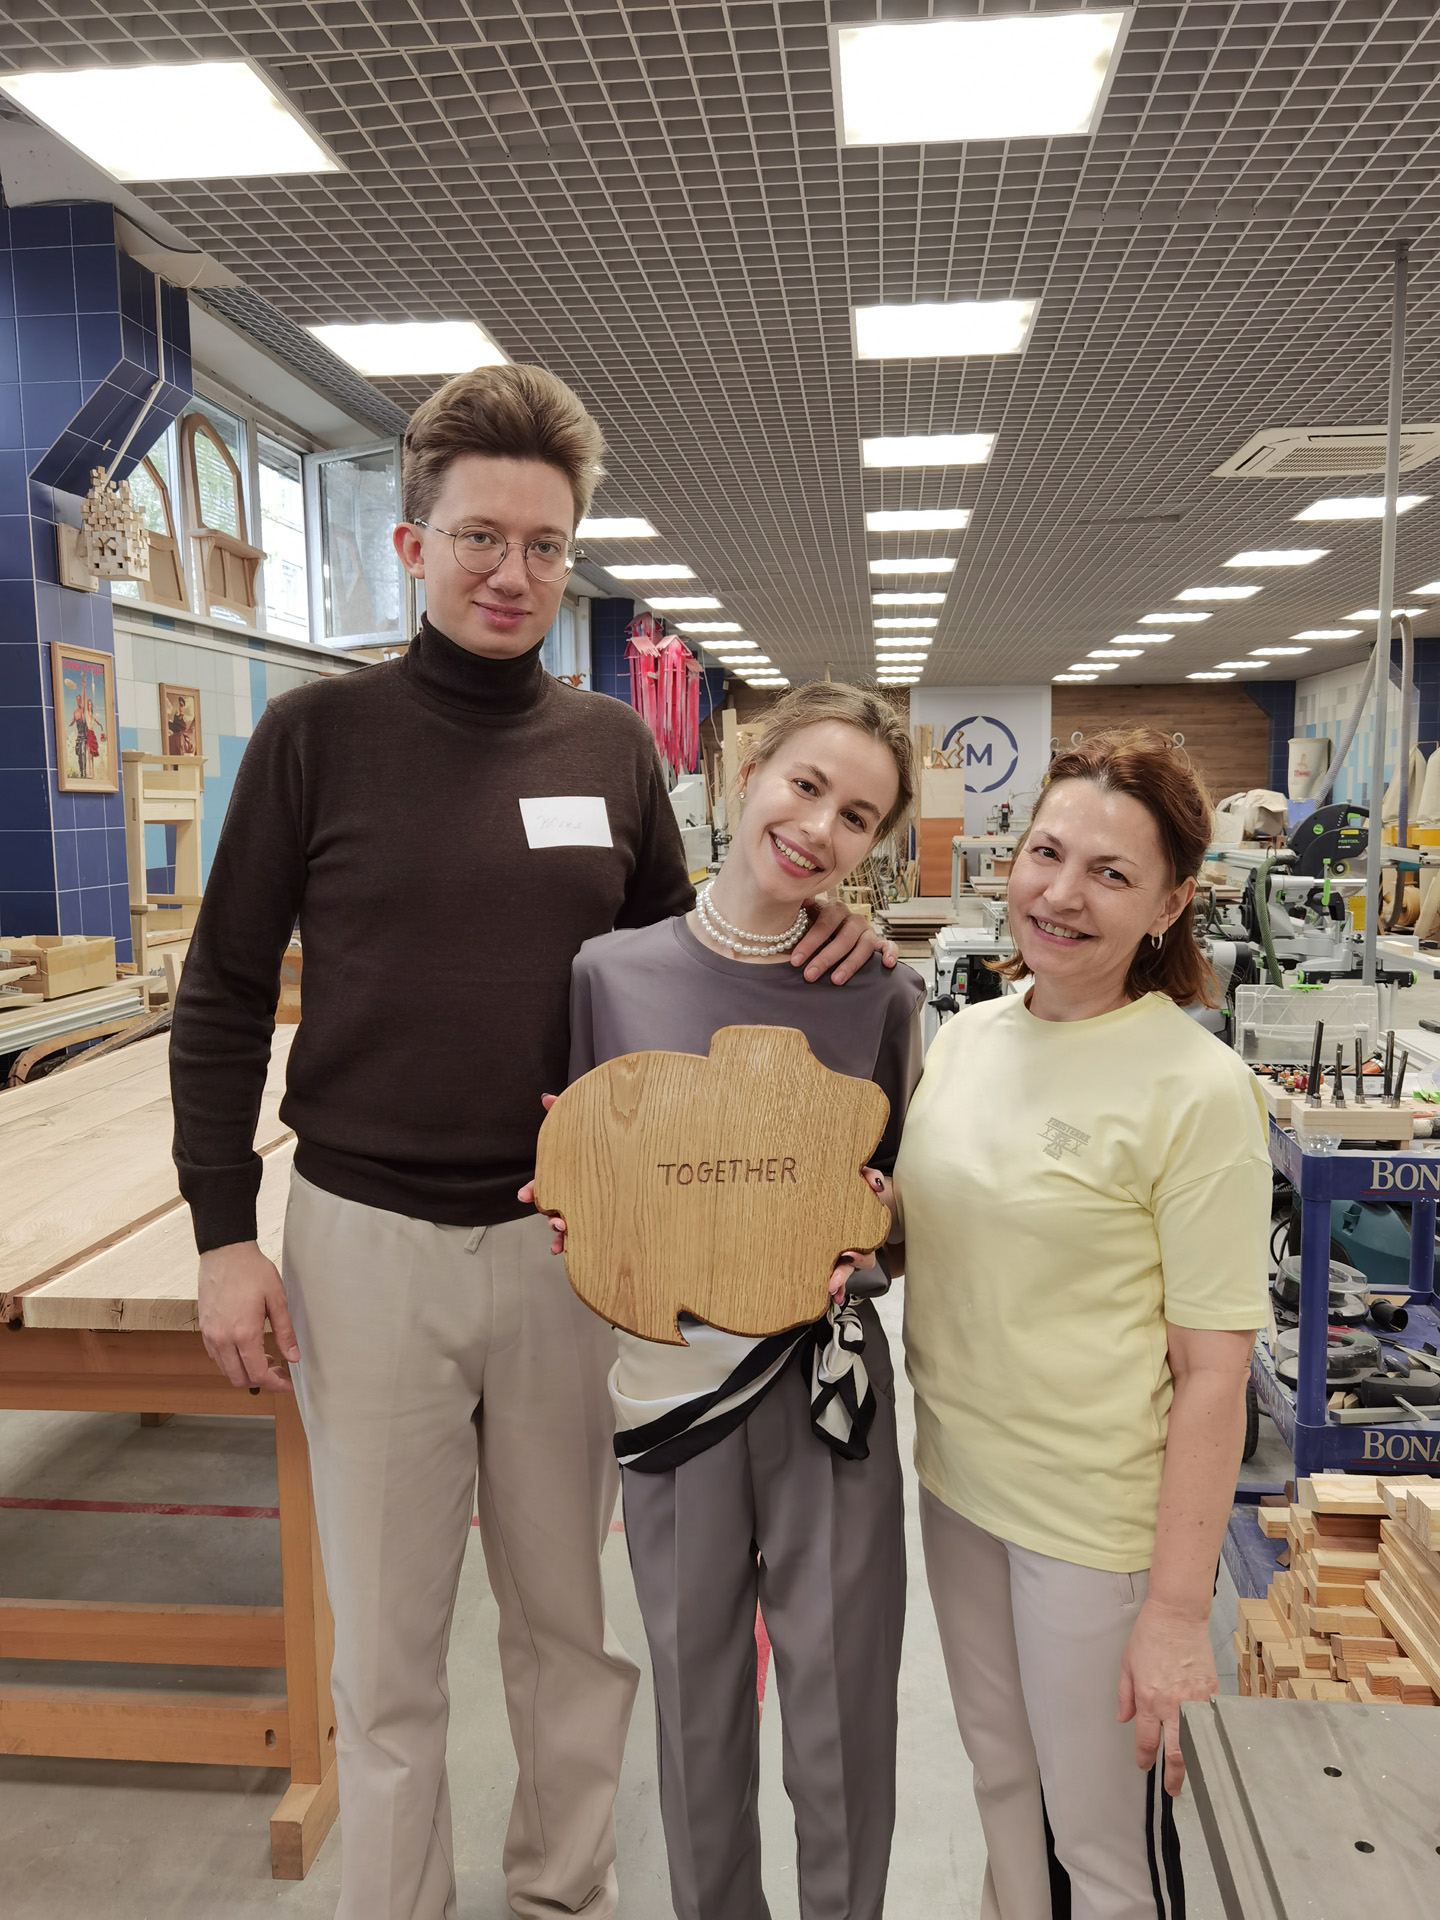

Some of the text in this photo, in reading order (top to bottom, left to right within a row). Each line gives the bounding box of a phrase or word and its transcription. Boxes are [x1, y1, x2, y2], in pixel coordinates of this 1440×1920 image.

[966, 743, 993, 766] M
[657, 1157, 797, 1186] TOGETHER
[1370, 1159, 1440, 1191] BON
